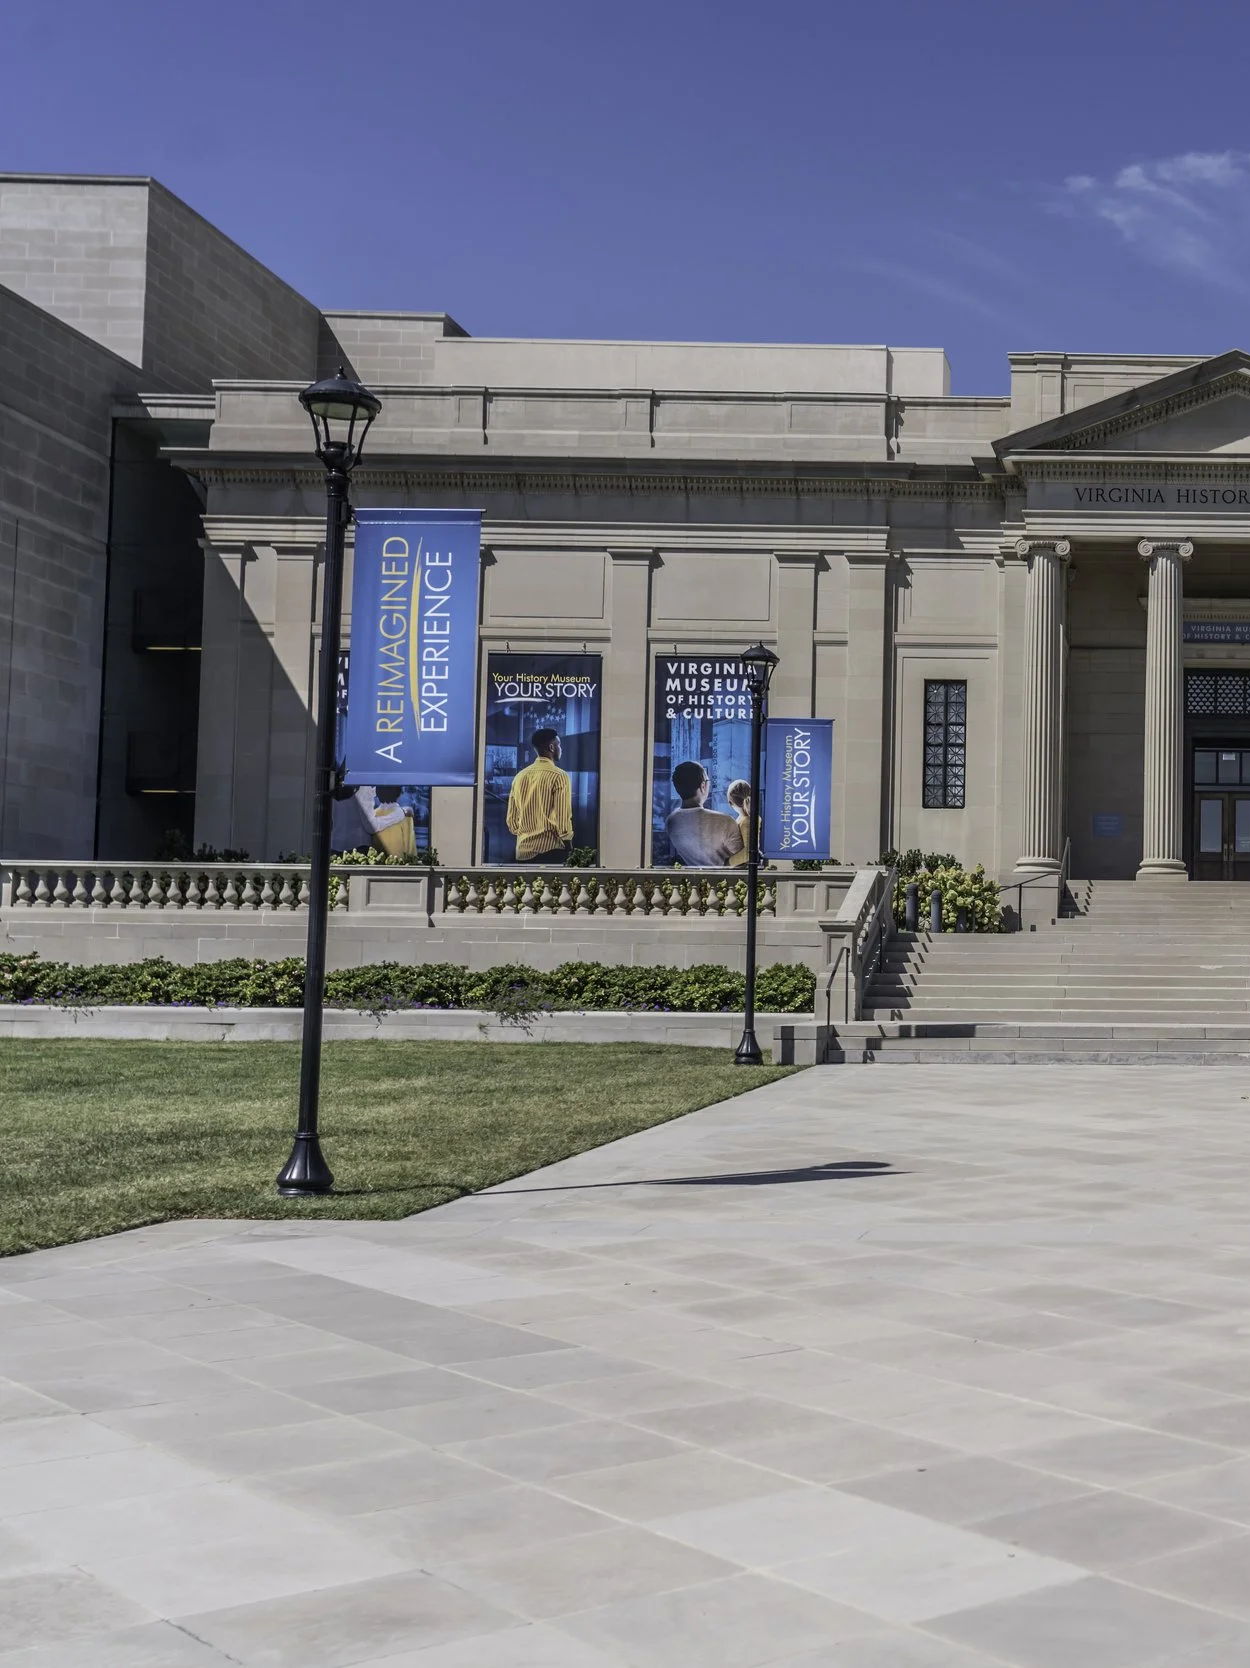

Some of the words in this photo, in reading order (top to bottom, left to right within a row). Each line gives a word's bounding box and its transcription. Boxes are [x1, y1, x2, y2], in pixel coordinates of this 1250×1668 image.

[1074, 488, 1165, 504] VIRGINIA
[376, 536, 409, 732] REIMAGINED
[420, 552, 452, 732] EXPERIENCE
[492, 673, 513, 682] Your
[516, 674, 548, 684] History
[550, 674, 590, 683] Museum
[666, 663, 757, 675] VIRGINIA
[494, 682, 542, 697] YOUR
[545, 683, 596, 698] STORY
[666, 695, 684, 704] OF
[666, 708, 677, 719] &
[376, 740, 402, 764] A
[782, 735, 793, 781] Museum
[793, 728, 811, 788] STORY
[780, 784, 794, 822] History
[792, 792, 809, 848] YOUR
[780, 827, 791, 850] Your
